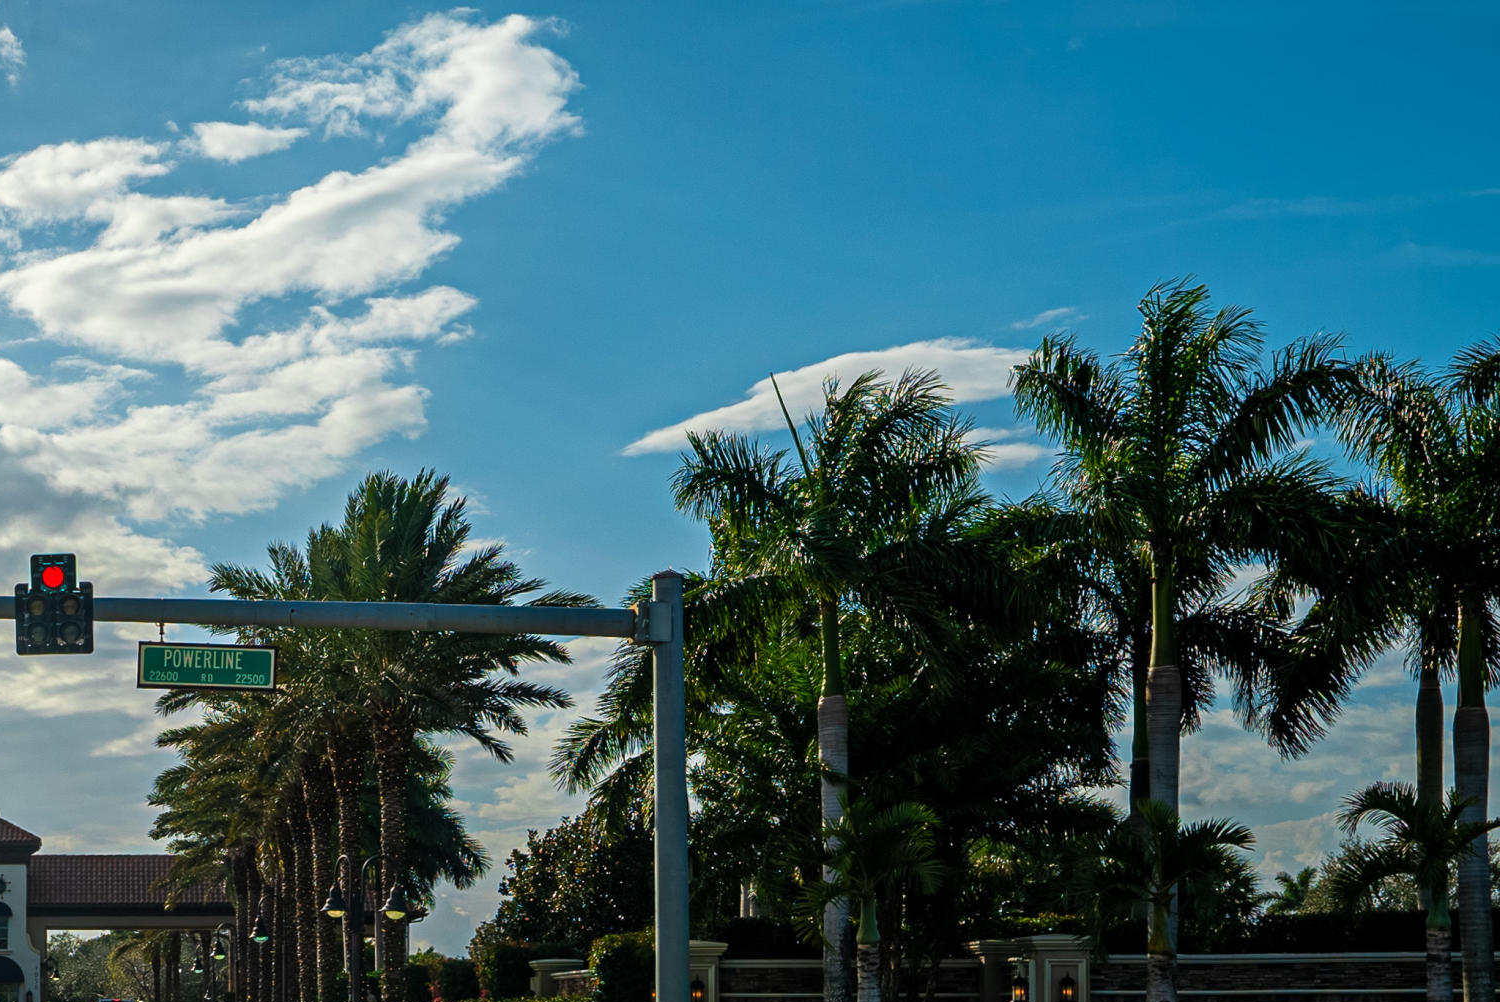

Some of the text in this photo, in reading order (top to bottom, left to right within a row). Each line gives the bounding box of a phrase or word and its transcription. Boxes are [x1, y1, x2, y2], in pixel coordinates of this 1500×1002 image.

[164, 649, 243, 670] POWERLINE
[149, 671, 265, 684] 22600 RD 22500
